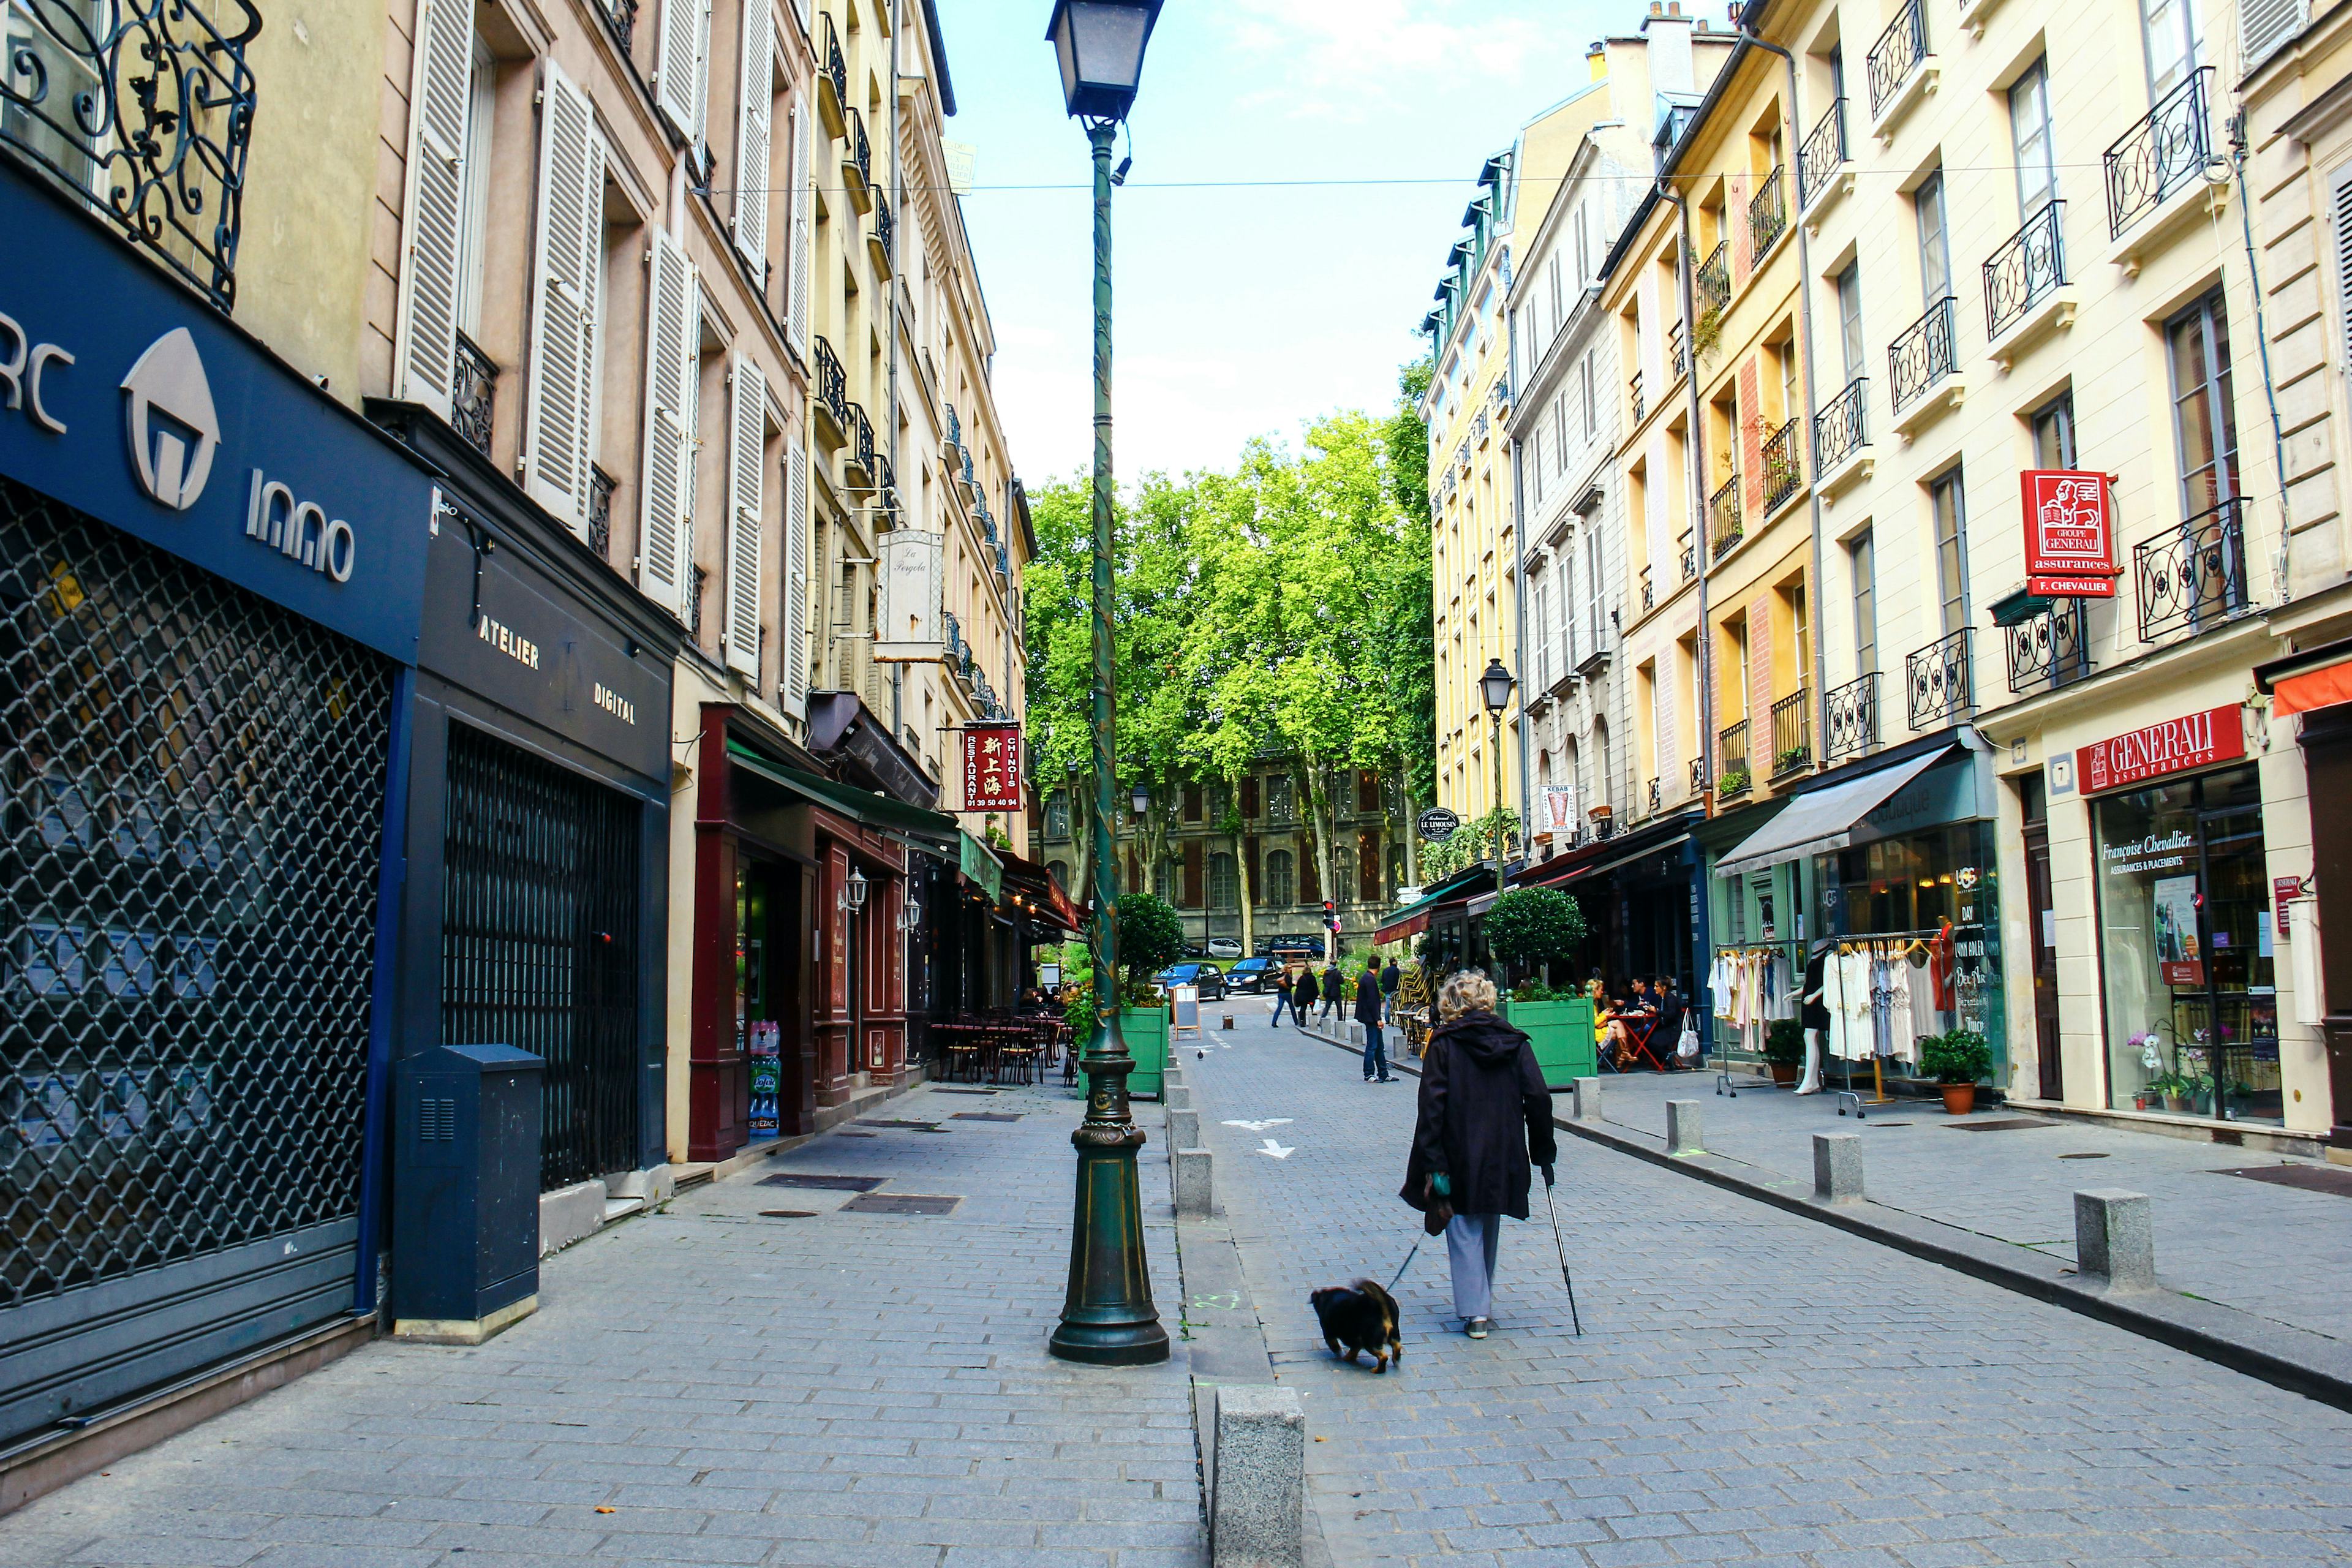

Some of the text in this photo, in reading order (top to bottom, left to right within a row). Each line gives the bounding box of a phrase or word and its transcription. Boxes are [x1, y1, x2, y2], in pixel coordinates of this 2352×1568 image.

[2057, 529, 2086, 538] GROUPE
[903, 546, 916, 559] La
[2046, 537, 2098, 550] GENERALI
[893, 560, 927, 576] Pergola
[2034, 559, 2109, 570] assurances
[2040, 581, 2108, 592] F. CHEVALLIER
[478, 615, 636, 726] ATELIER DIGITAL
[2110, 710, 2215, 774] GENERALI
[967, 736, 977, 800] RESTAURANT
[981, 736, 1003, 796] 新上海
[1007, 737, 1017, 788] CHINOIS
[2114, 749, 2215, 785] assurances
[2058, 766, 2063, 782] 7
[2103, 830, 2192, 861] Françoise Chevallier
[2110, 855, 2183, 875] ASSURANCES & PLACEMENTS
[1956, 867, 1978, 889] UGG
[1962, 905, 1973, 922] DAY
[1954, 940, 1985, 958] LYNN ADLER
